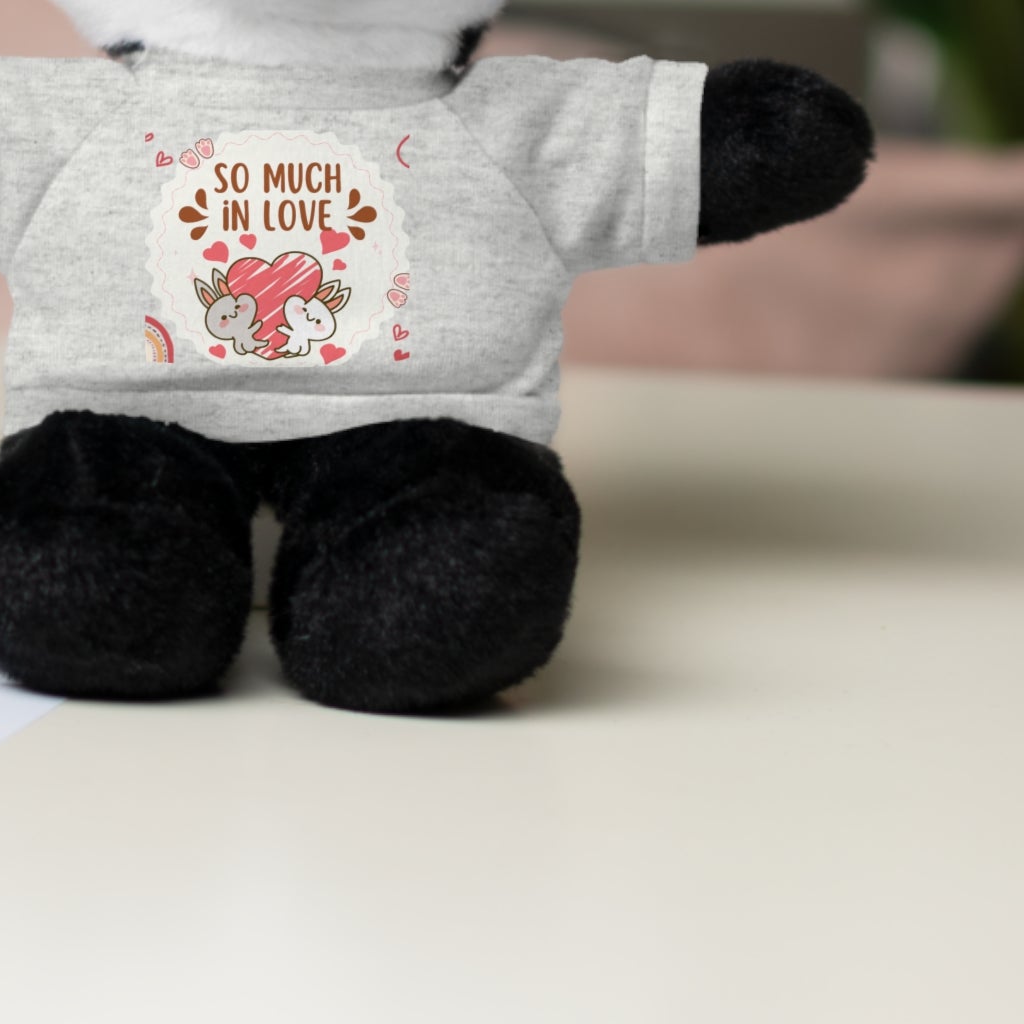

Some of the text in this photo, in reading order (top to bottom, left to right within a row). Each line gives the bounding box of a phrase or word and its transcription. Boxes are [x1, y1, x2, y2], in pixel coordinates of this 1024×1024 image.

[213, 162, 342, 194] SO MUCH
[263, 199, 332, 231] LOVE
